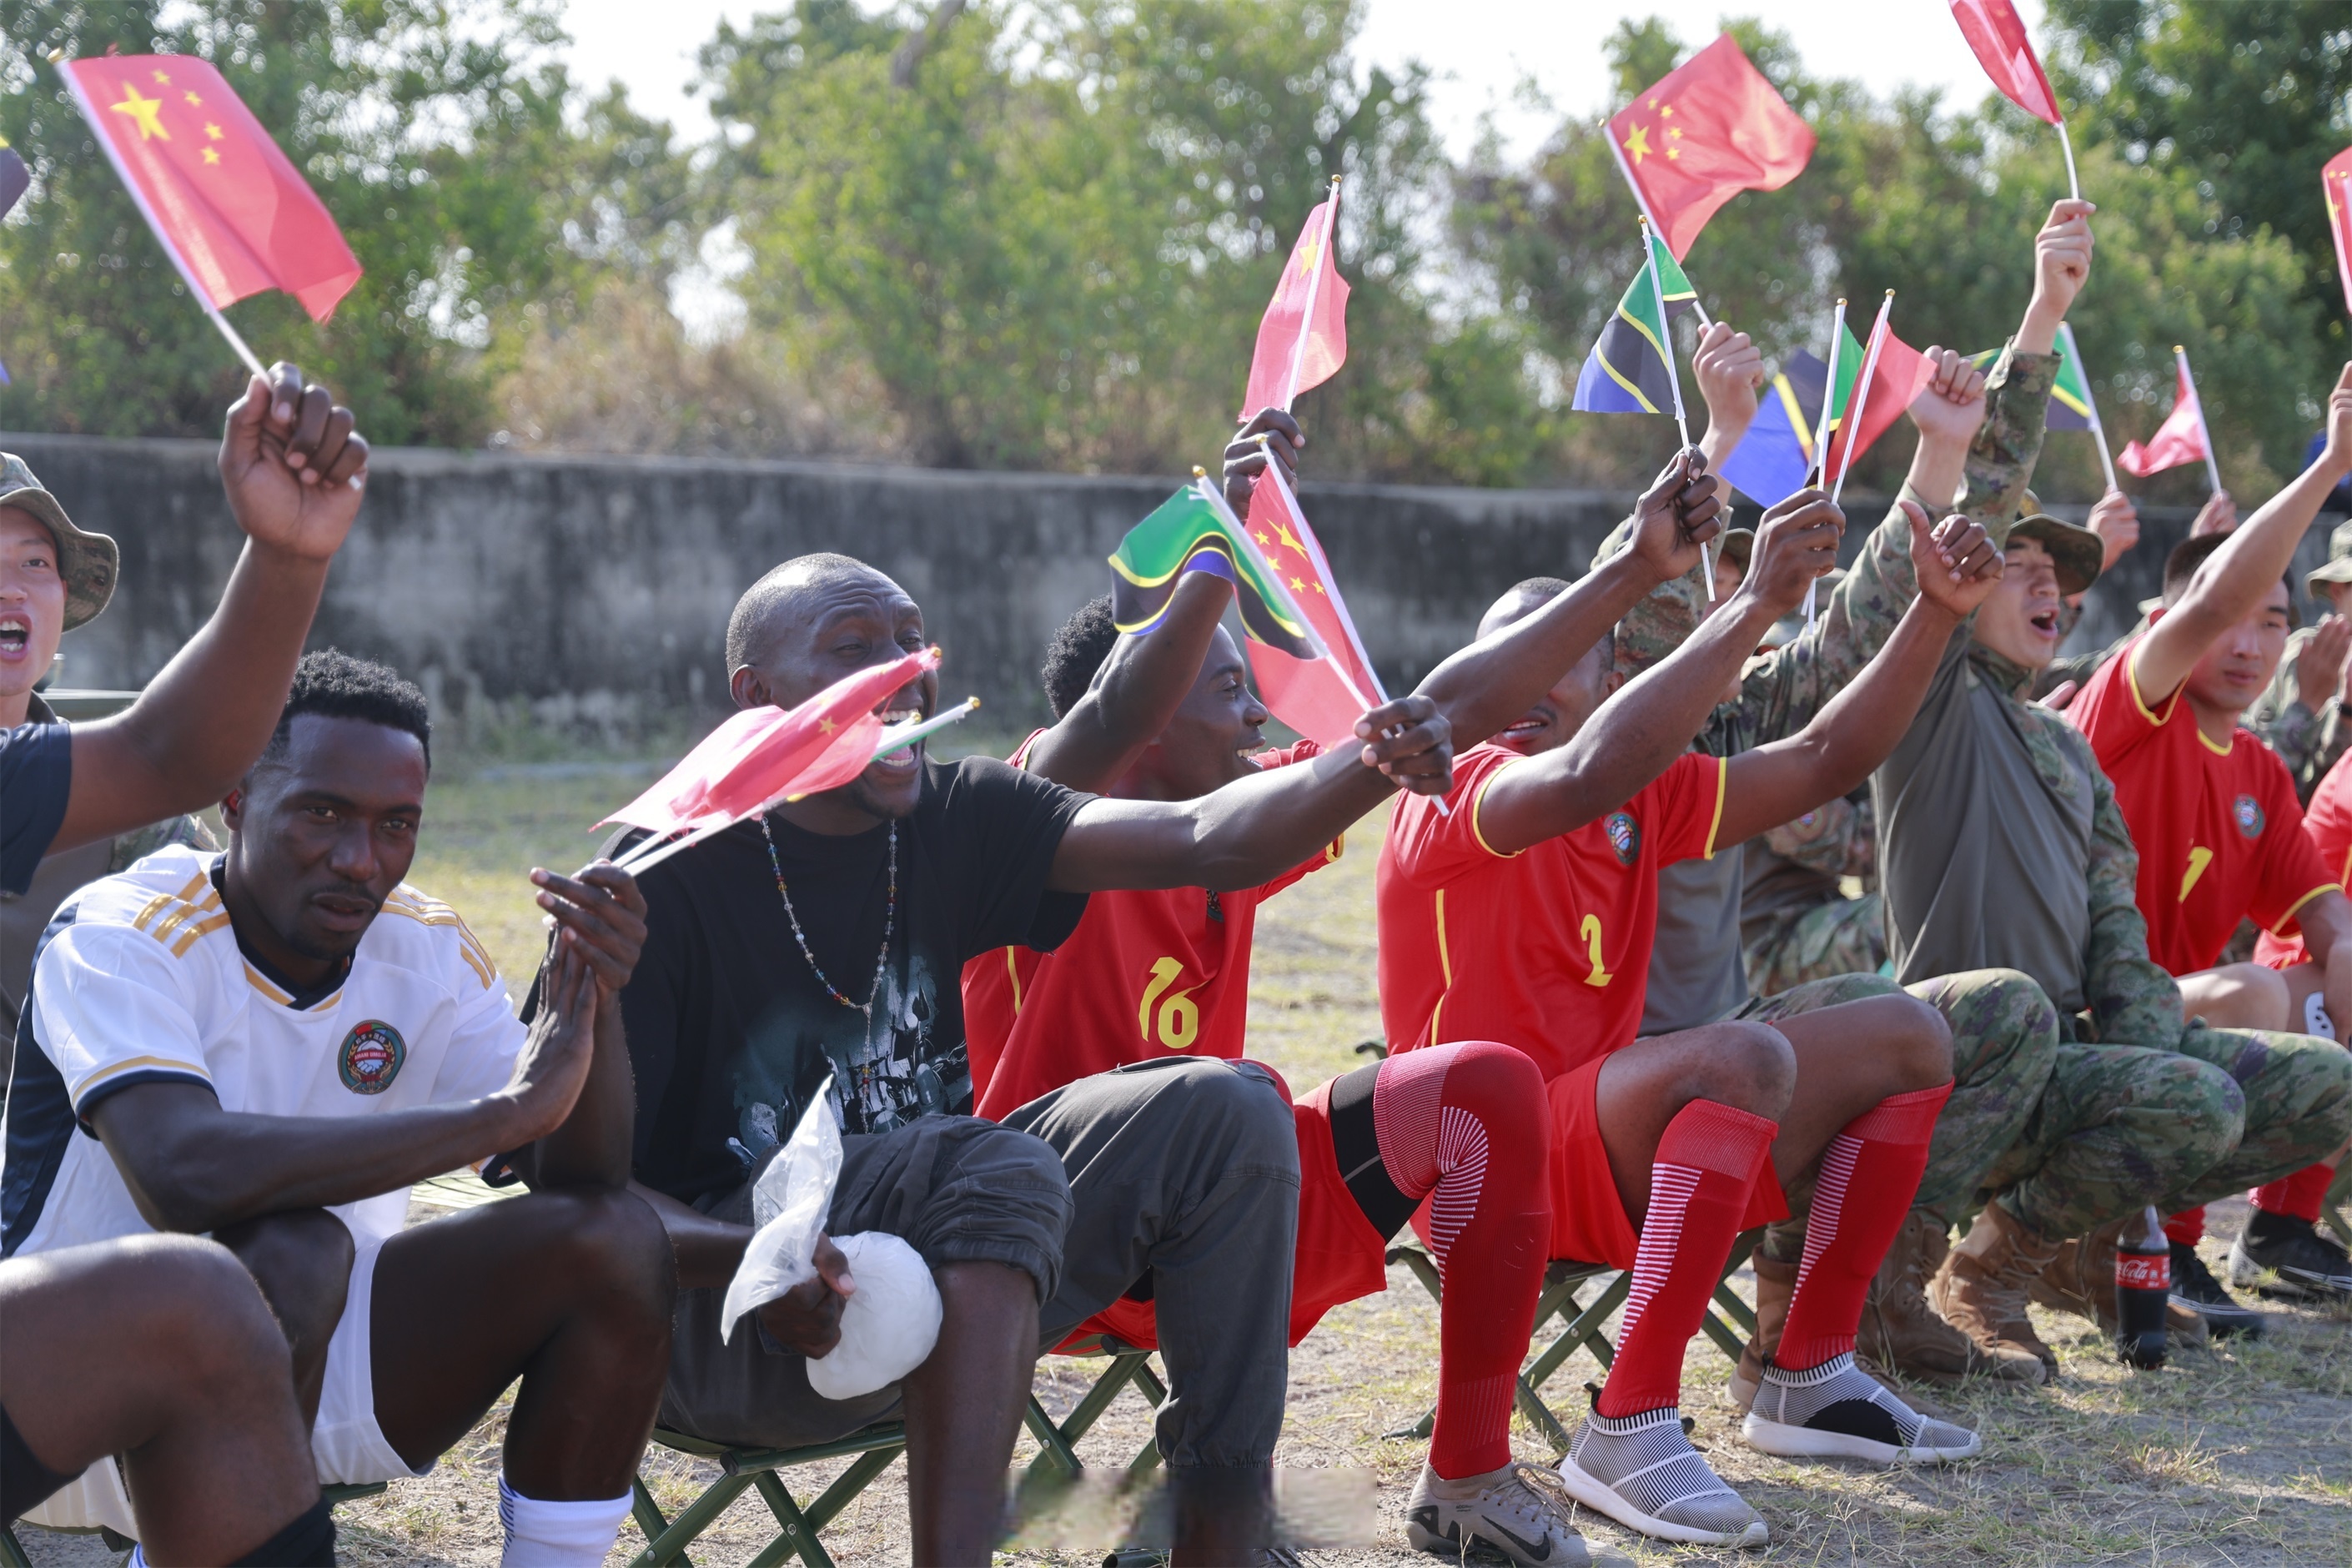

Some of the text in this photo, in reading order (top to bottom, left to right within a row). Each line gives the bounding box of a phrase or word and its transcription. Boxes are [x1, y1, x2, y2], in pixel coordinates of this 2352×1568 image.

[1580, 913, 1614, 988] 2
[1138, 956, 1211, 1048] 16
[354, 1052, 369, 1060] AMANI
